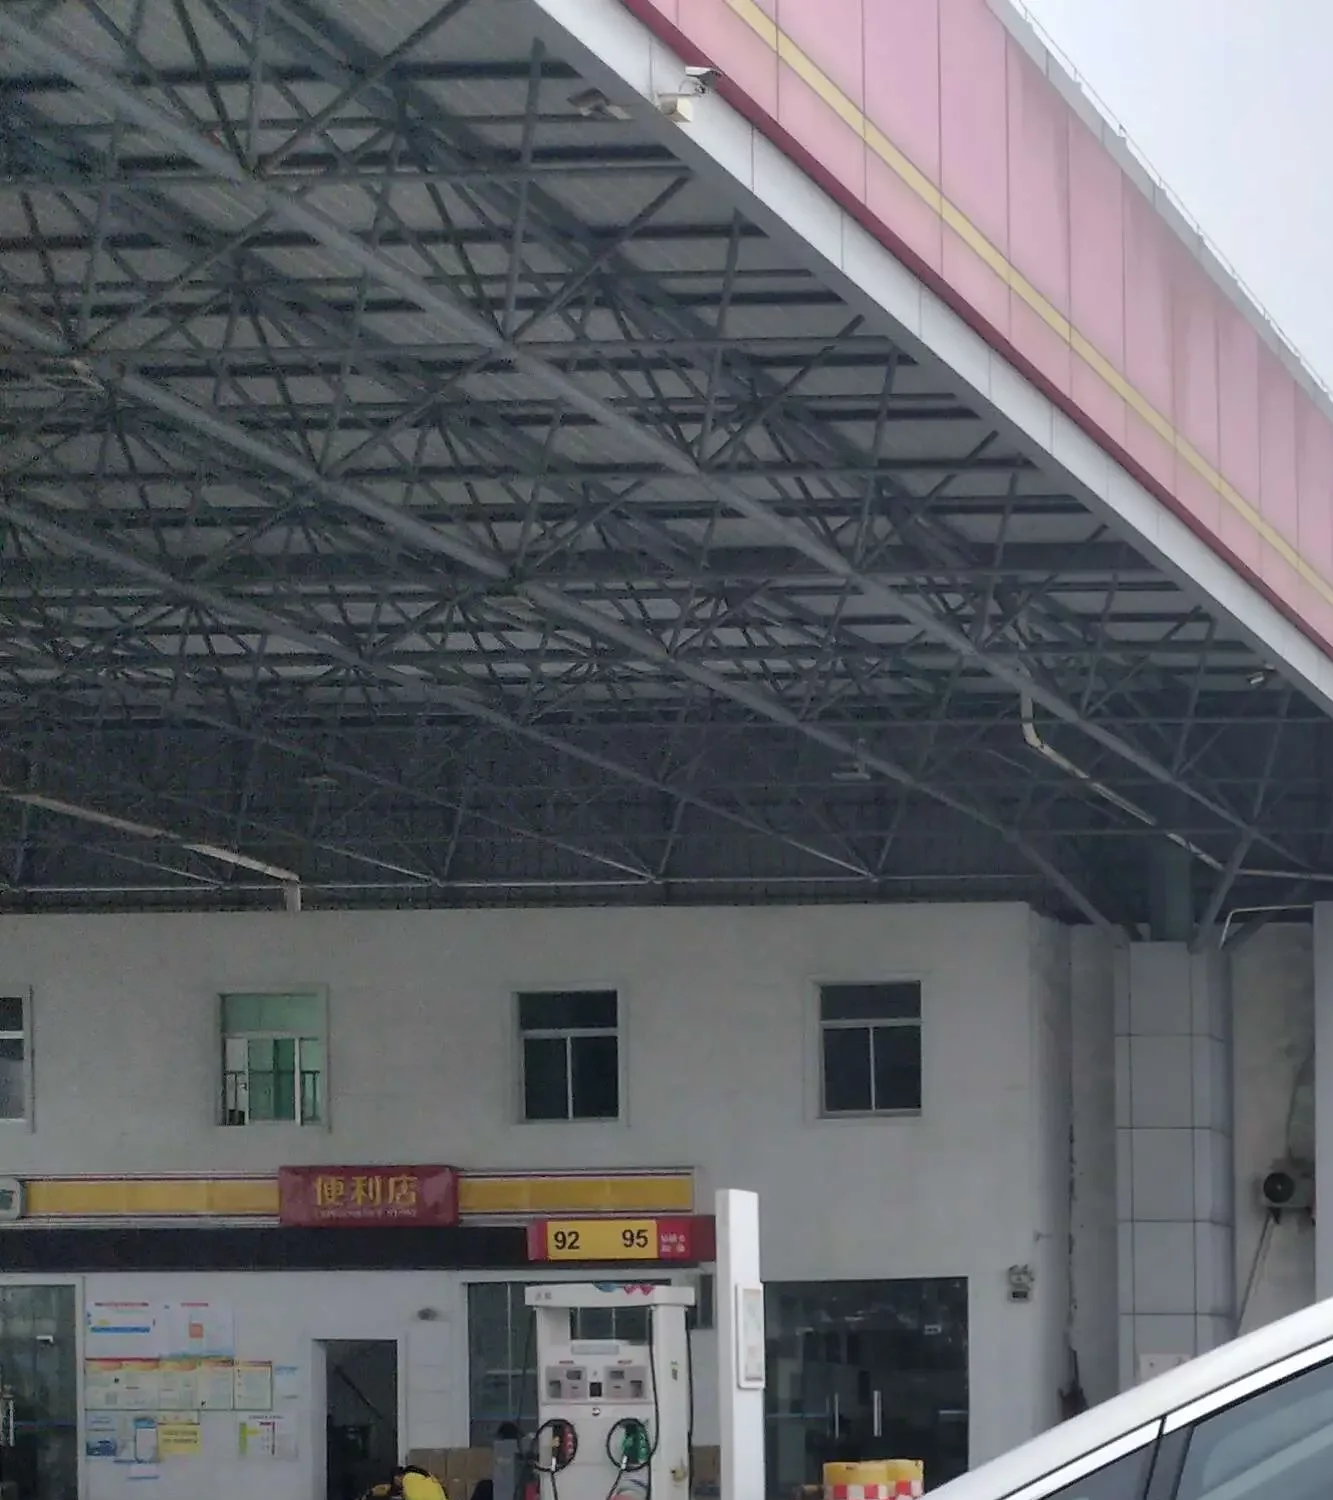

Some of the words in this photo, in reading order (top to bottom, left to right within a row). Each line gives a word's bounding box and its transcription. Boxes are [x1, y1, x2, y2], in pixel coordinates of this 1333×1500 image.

[315, 1174, 418, 1207] 便利店
[553, 1230, 581, 1251] 92
[621, 1228, 649, 1249] 95
